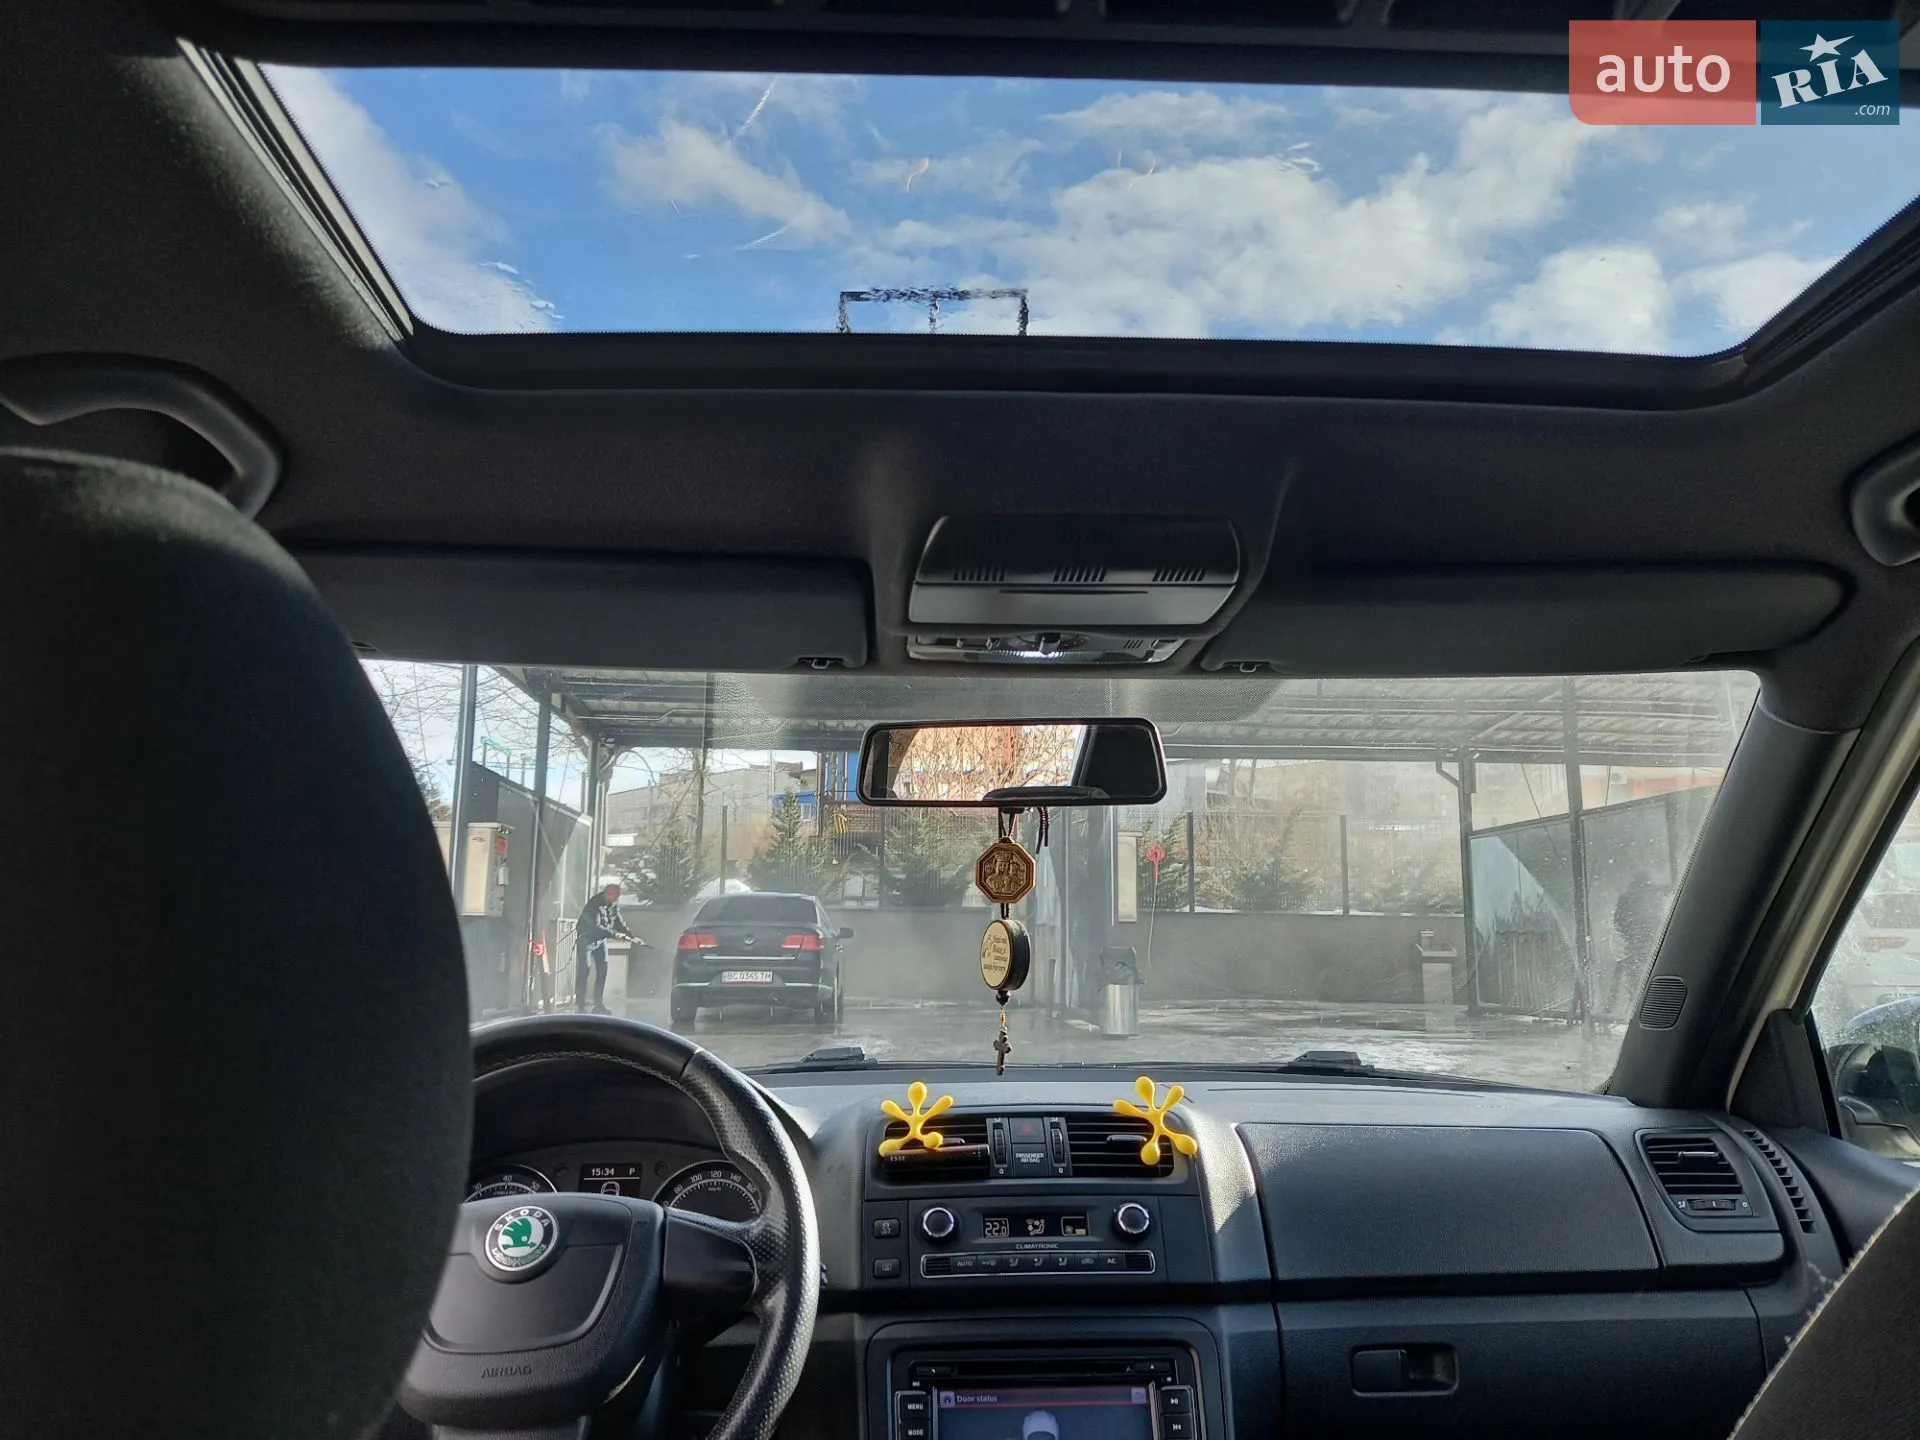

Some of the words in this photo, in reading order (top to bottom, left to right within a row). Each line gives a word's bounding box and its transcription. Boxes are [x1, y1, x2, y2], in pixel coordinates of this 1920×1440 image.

[592, 1167, 615, 1176] 15:34
[629, 1167, 635, 1176] P
[710, 1170, 722, 1178] 120
[502, 1174, 513, 1182] 40
[690, 1173, 703, 1182] 100
[730, 1173, 742, 1182] 140
[481, 1365, 532, 1378] AIRBAG
[956, 1395, 976, 1403] Door
[976, 1395, 998, 1403] status
[907, 1403, 924, 1411] MENU
